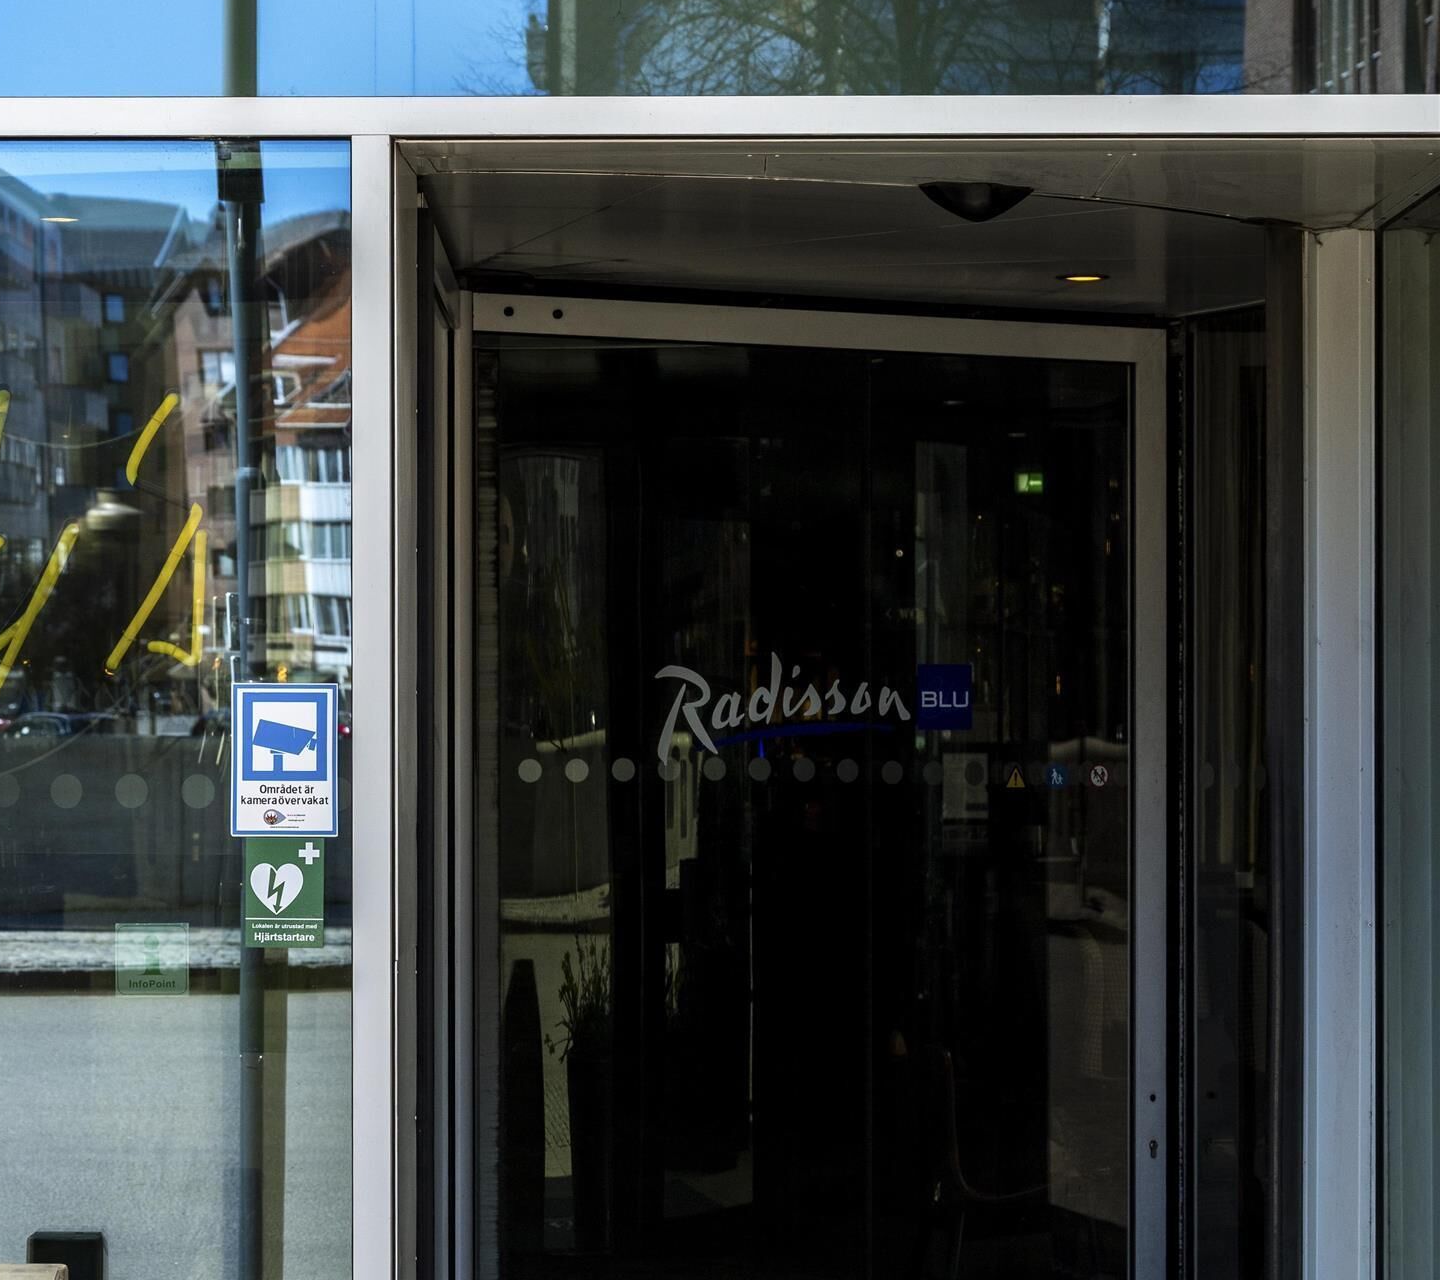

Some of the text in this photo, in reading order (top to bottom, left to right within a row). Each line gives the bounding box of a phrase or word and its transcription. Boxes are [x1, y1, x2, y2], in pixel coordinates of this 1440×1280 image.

[654, 651, 970, 767] Radisson BLU
[259, 783, 315, 794] Området är
[240, 795, 329, 805] kameraövervakat
[254, 932, 315, 944] Hjärtstartare
[128, 979, 176, 989] InfoPoint
